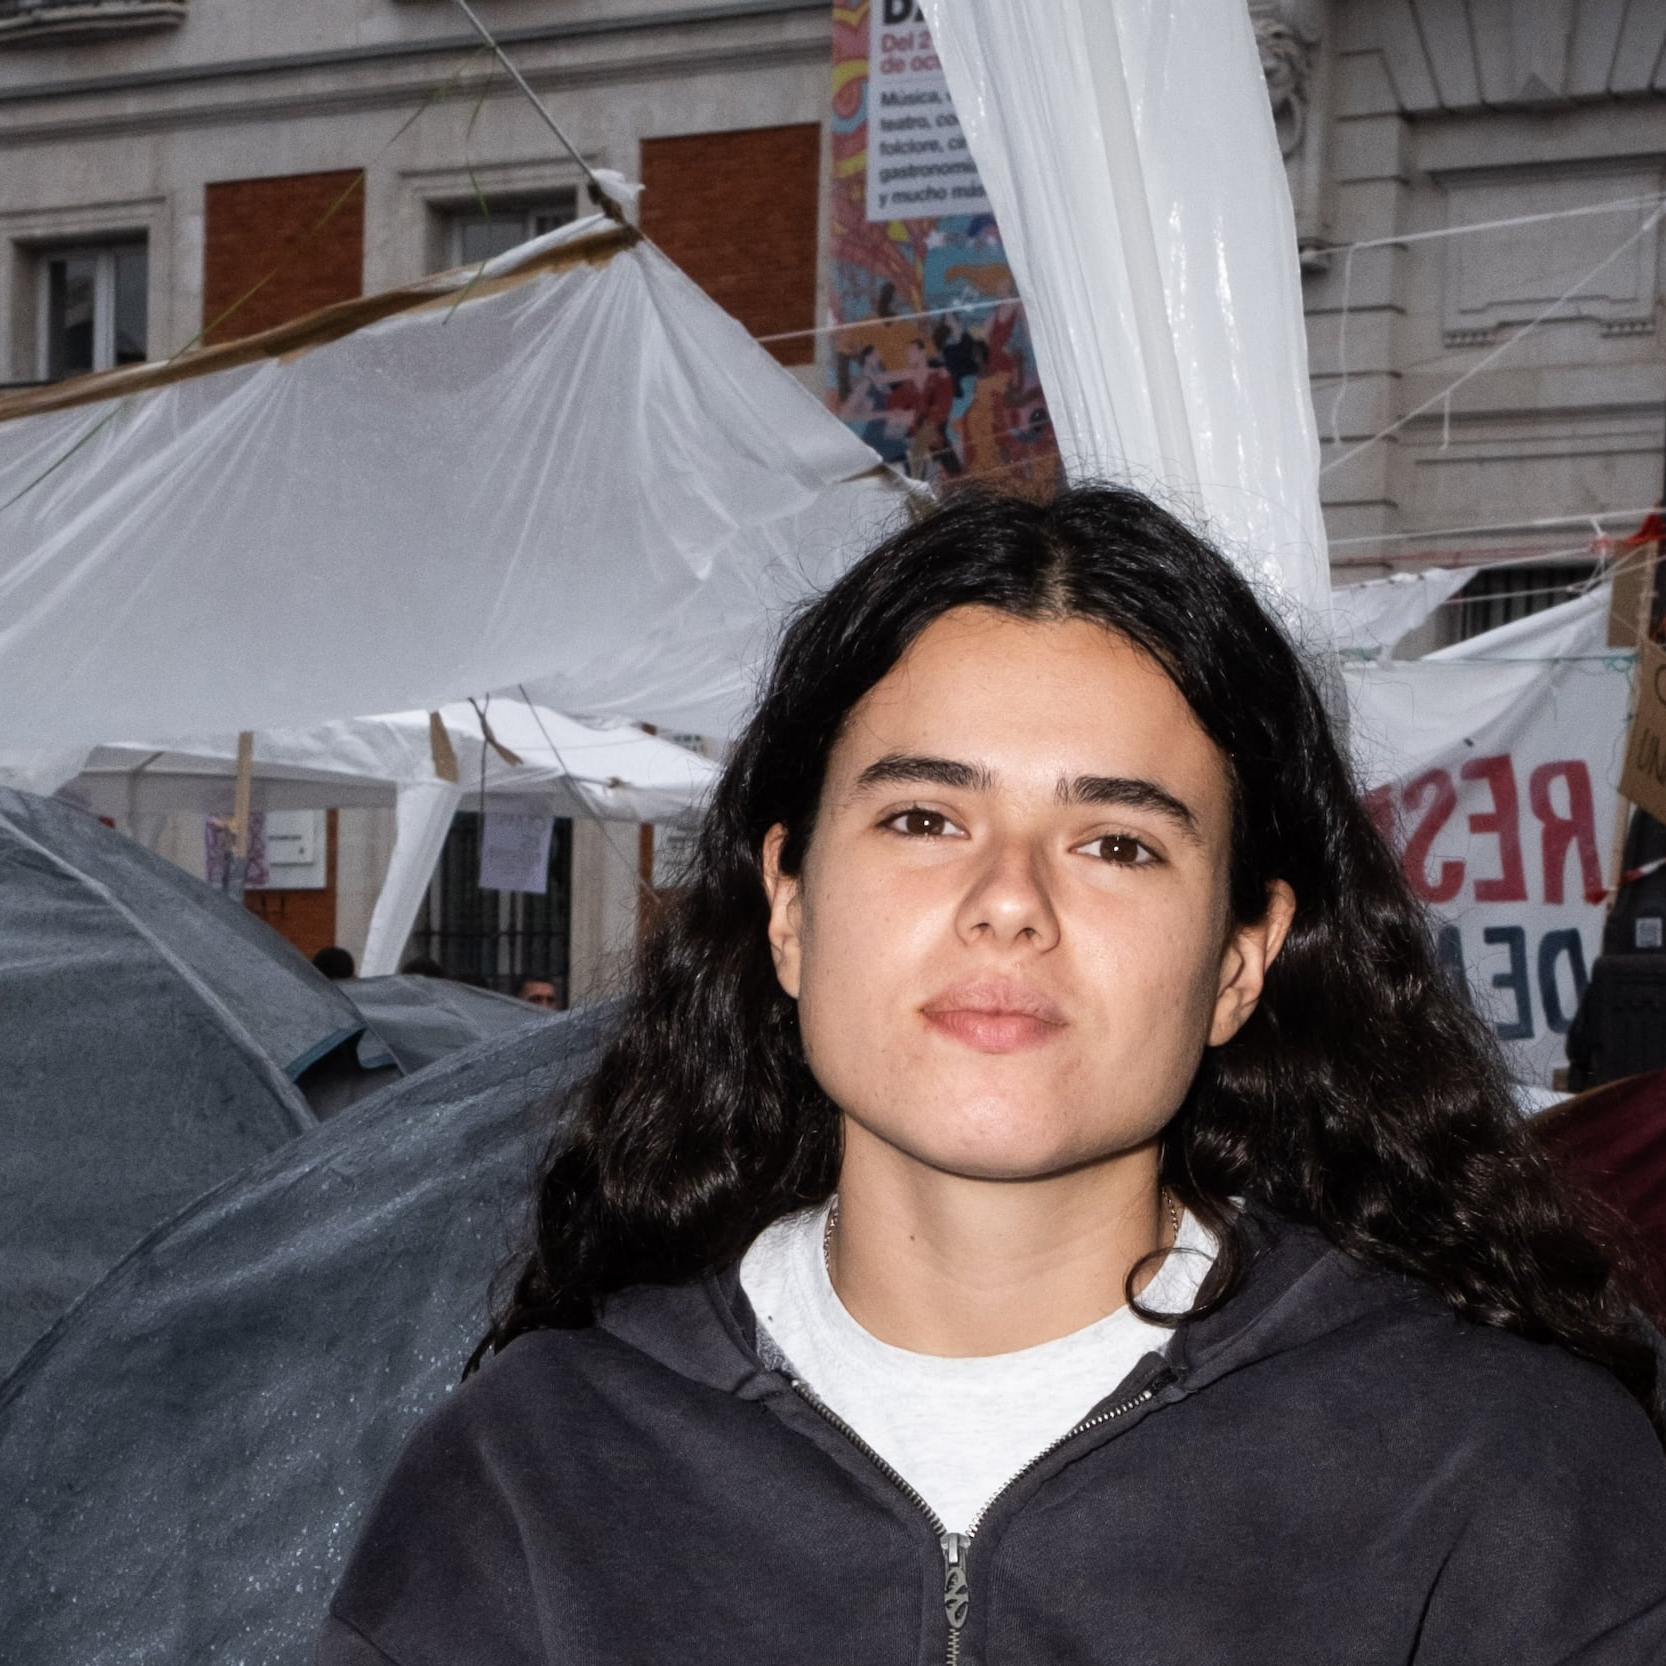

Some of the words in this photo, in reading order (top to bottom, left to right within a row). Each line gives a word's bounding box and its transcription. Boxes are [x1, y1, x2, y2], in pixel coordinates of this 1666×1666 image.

[882, 31, 914, 52] Del
[880, 55, 906, 75] de
[879, 193, 888, 208] y
[892, 186, 947, 203] mucho
